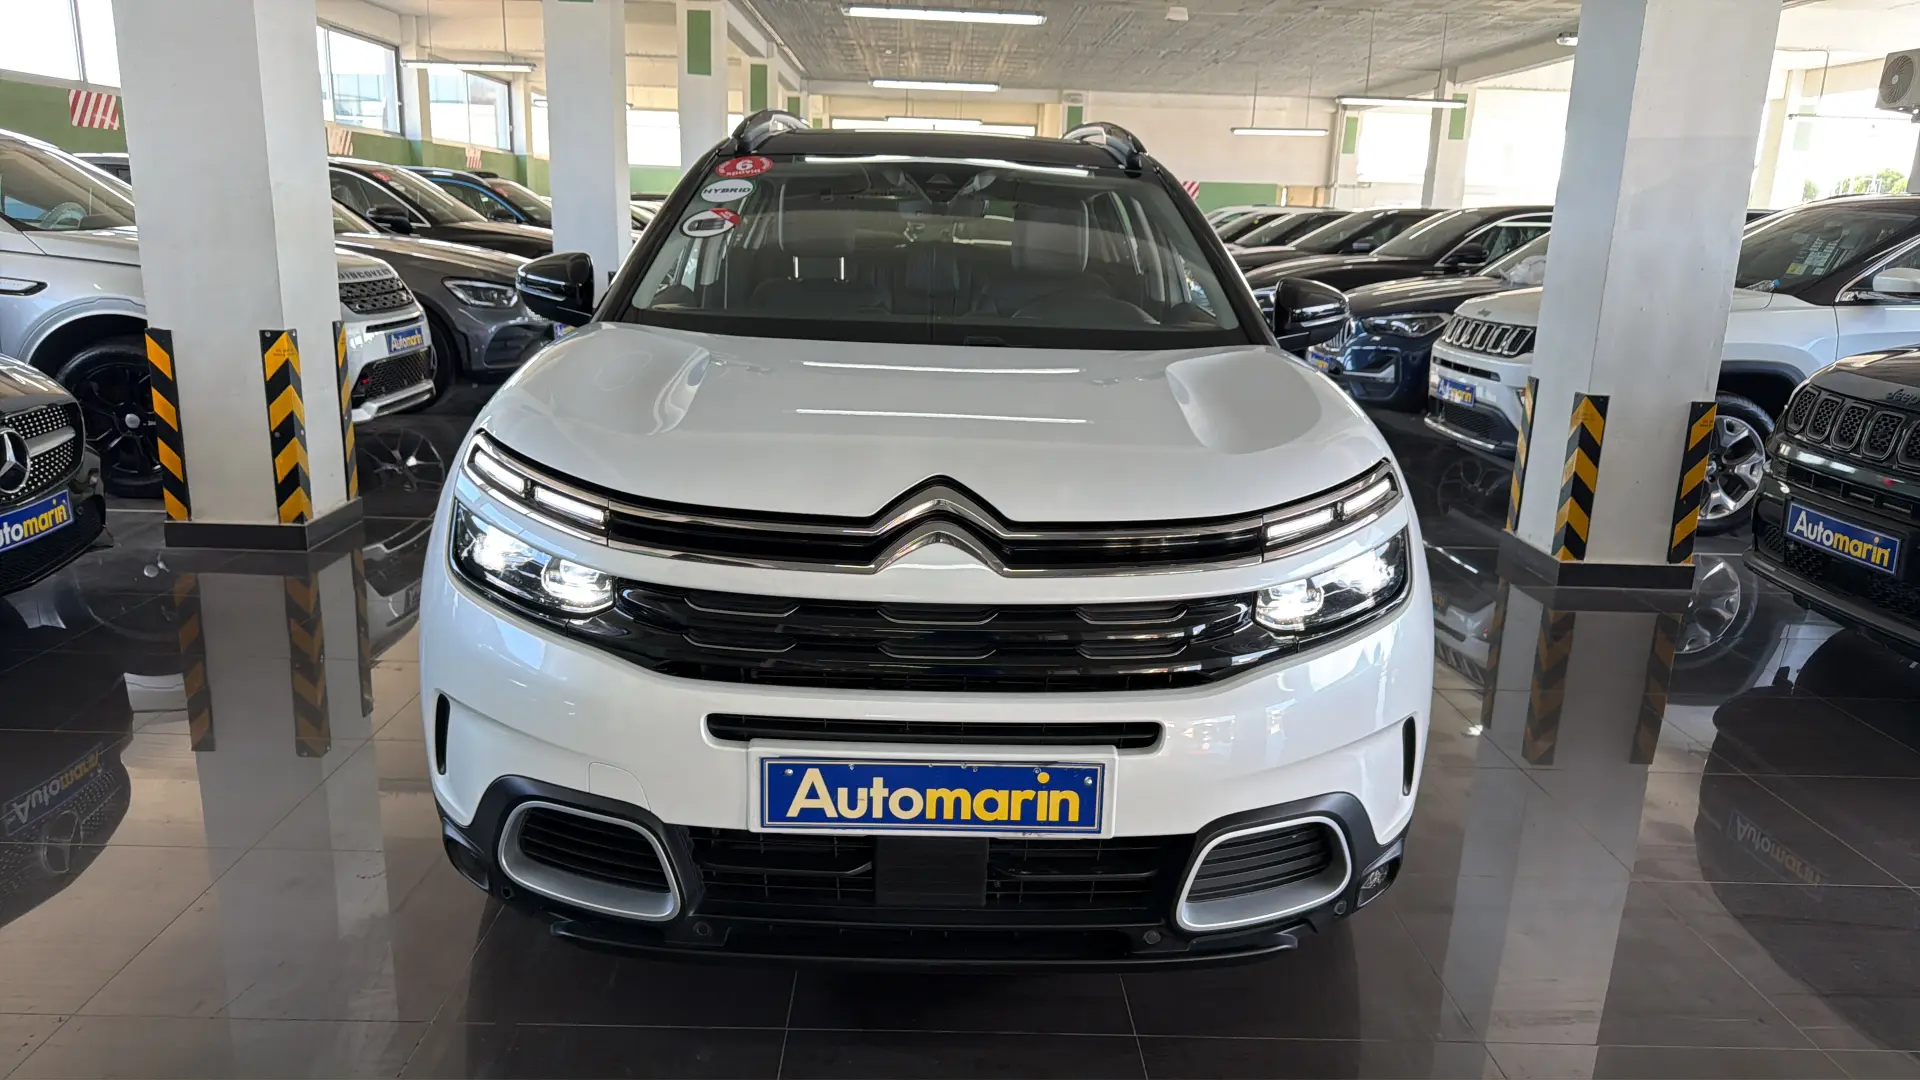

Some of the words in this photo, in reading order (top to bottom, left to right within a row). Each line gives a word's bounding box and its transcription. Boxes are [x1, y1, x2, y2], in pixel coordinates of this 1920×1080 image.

[736, 159, 753, 171] 6
[1792, 510, 1891, 567] Automarin
[785, 767, 1080, 822] Automarin
